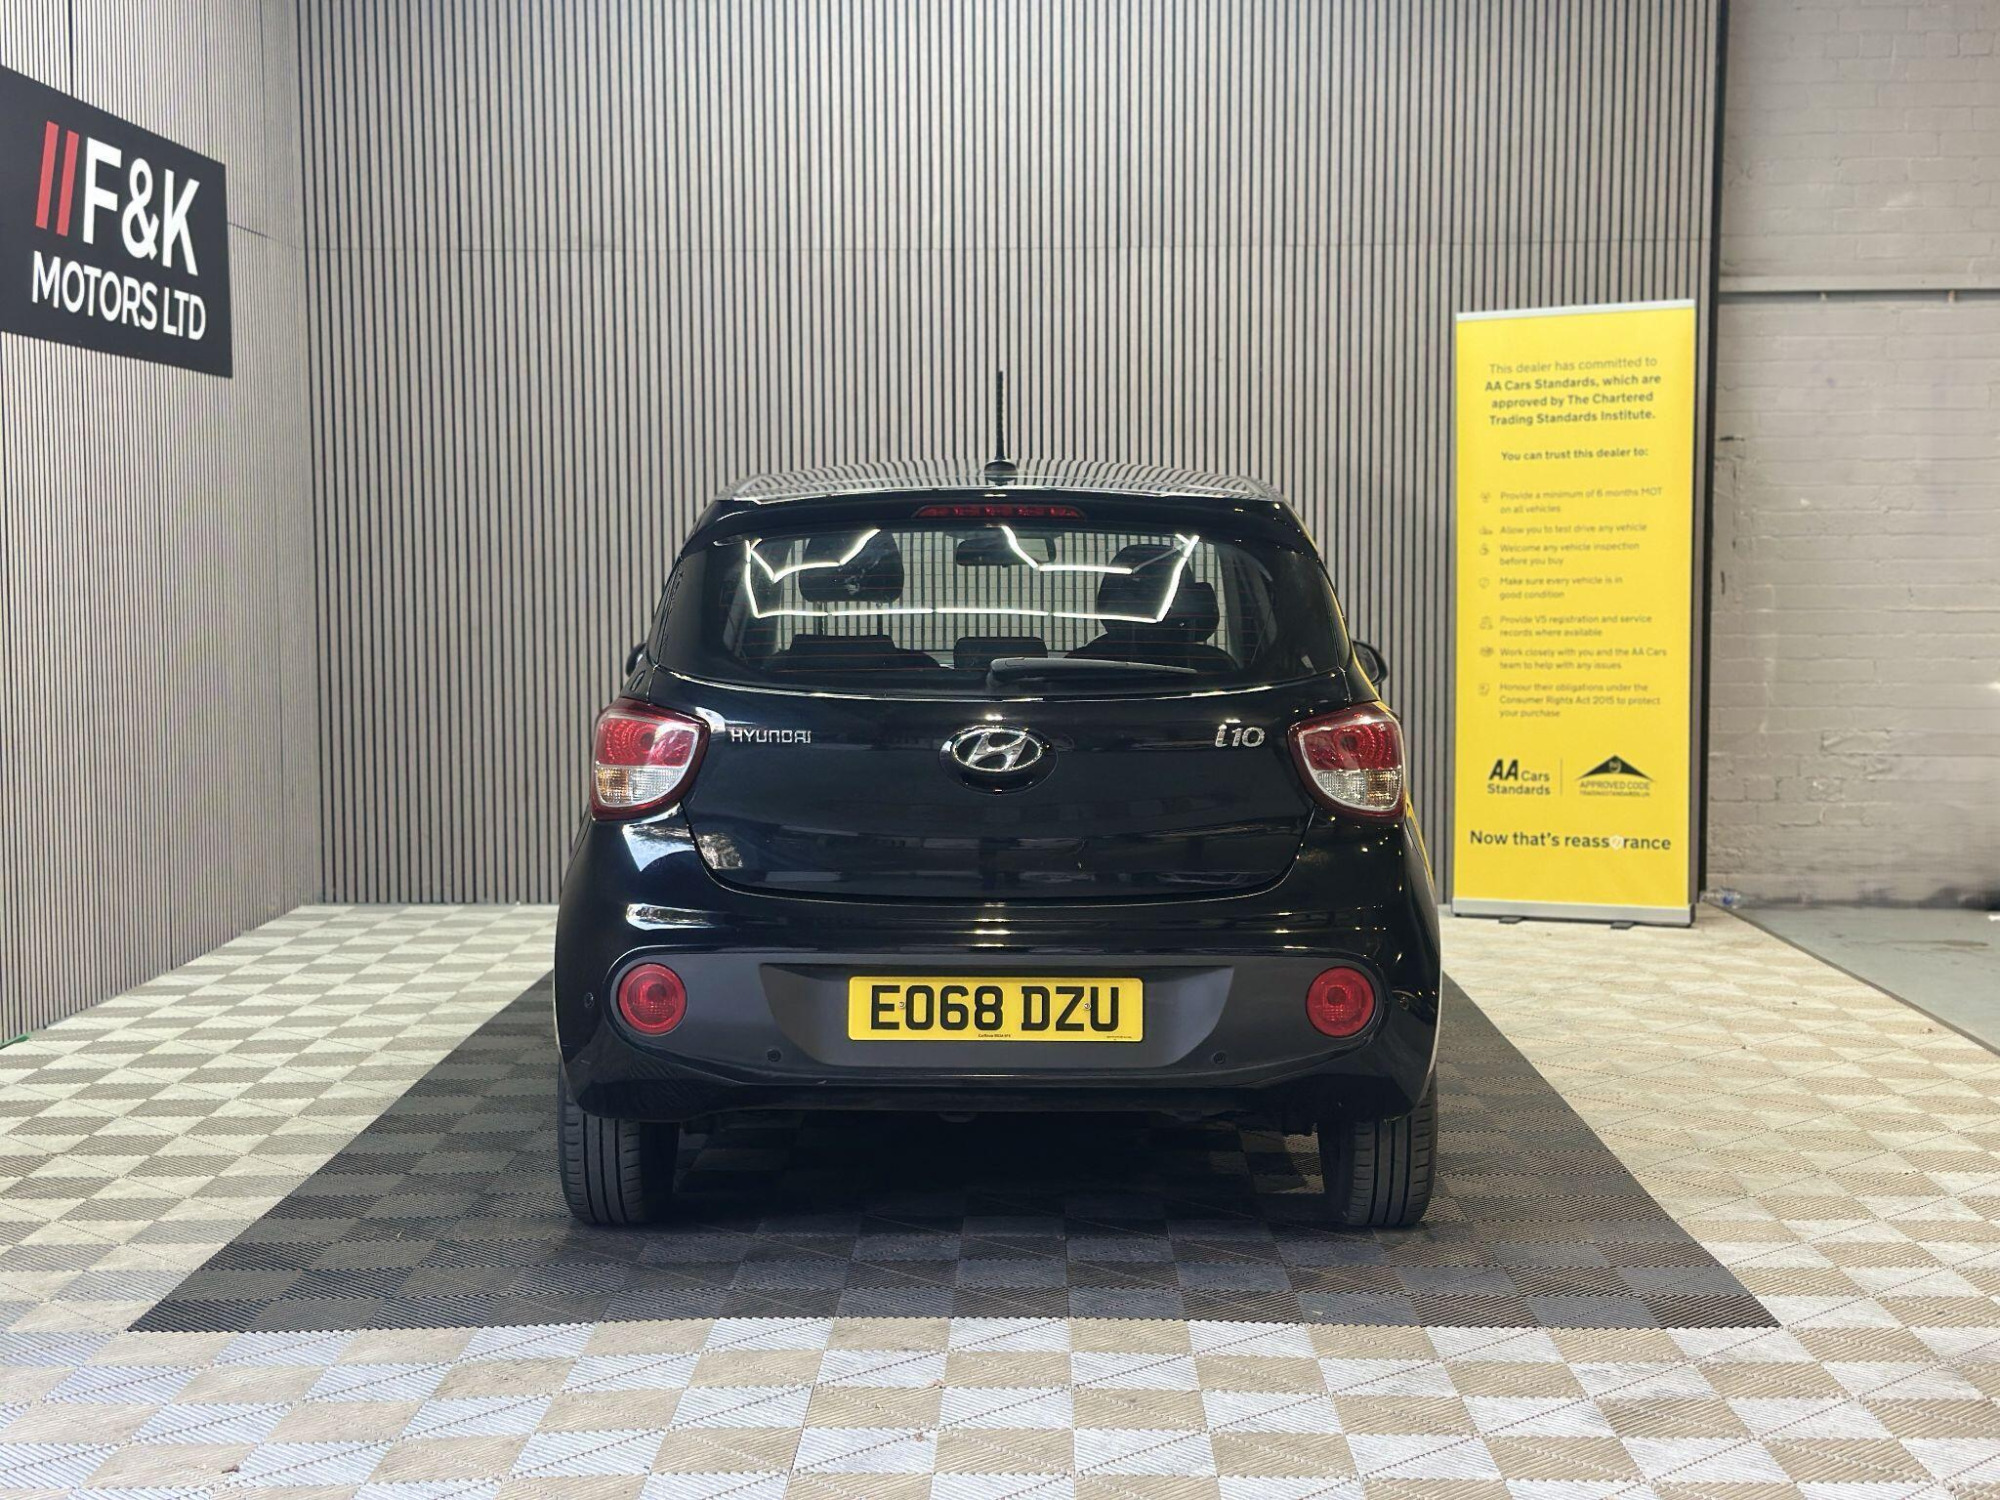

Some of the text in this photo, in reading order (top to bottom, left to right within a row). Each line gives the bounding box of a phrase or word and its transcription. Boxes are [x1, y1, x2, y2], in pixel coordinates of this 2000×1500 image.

[83, 136, 200, 276] F&K
[32, 250, 206, 341] MOTORS LTD
[1490, 357, 1657, 374] This dealer has committed to
[1485, 375, 1661, 392] AA Cars Standards, which are
[1492, 392, 1653, 410] approved by The Chartered
[1490, 410, 1655, 426] Trading Standards Institute.
[1501, 448, 1648, 462] You can trust this dealer to:
[1500, 491, 1533, 500] Provide
[1544, 490, 1583, 499] minimum
[1586, 489, 1595, 498] of
[1606, 489, 1638, 498] months
[1641, 487, 1662, 496] MOT
[1500, 504, 1561, 514] on all vehicles
[1500, 522, 1646, 535] Allow you to test drive any vehicle
[1500, 541, 1639, 554] Welcome any vehicle inspection
[1500, 556, 1563, 566] before you buy
[1500, 577, 1523, 586] Make
[1545, 577, 1569, 586] every
[1572, 576, 1602, 584] vehicle
[1604, 576, 1612, 584] is
[1615, 576, 1622, 584] in
[1500, 590, 1564, 600] good condition
[1500, 614, 1652, 624] Provide V5 registration and service
[1500, 628, 1602, 637] records where available
[1500, 647, 1667, 658] Work closely with you and the AA Cars
[1500, 661, 1621, 671] team to help with any issues
[1500, 683, 1648, 693] Honour their obligations under the
[1500, 696, 1660, 706] Consumer Rights Act 2015 to protect
[1500, 708, 1560, 718] your purchase
[1488, 759, 1550, 782] AA Cars
[1488, 784, 1550, 796] Standards
[1580, 781, 1650, 790] APPROVED CODE
[1470, 831, 1508, 844] Now
[870, 985, 1119, 1032] EO68 DZU
